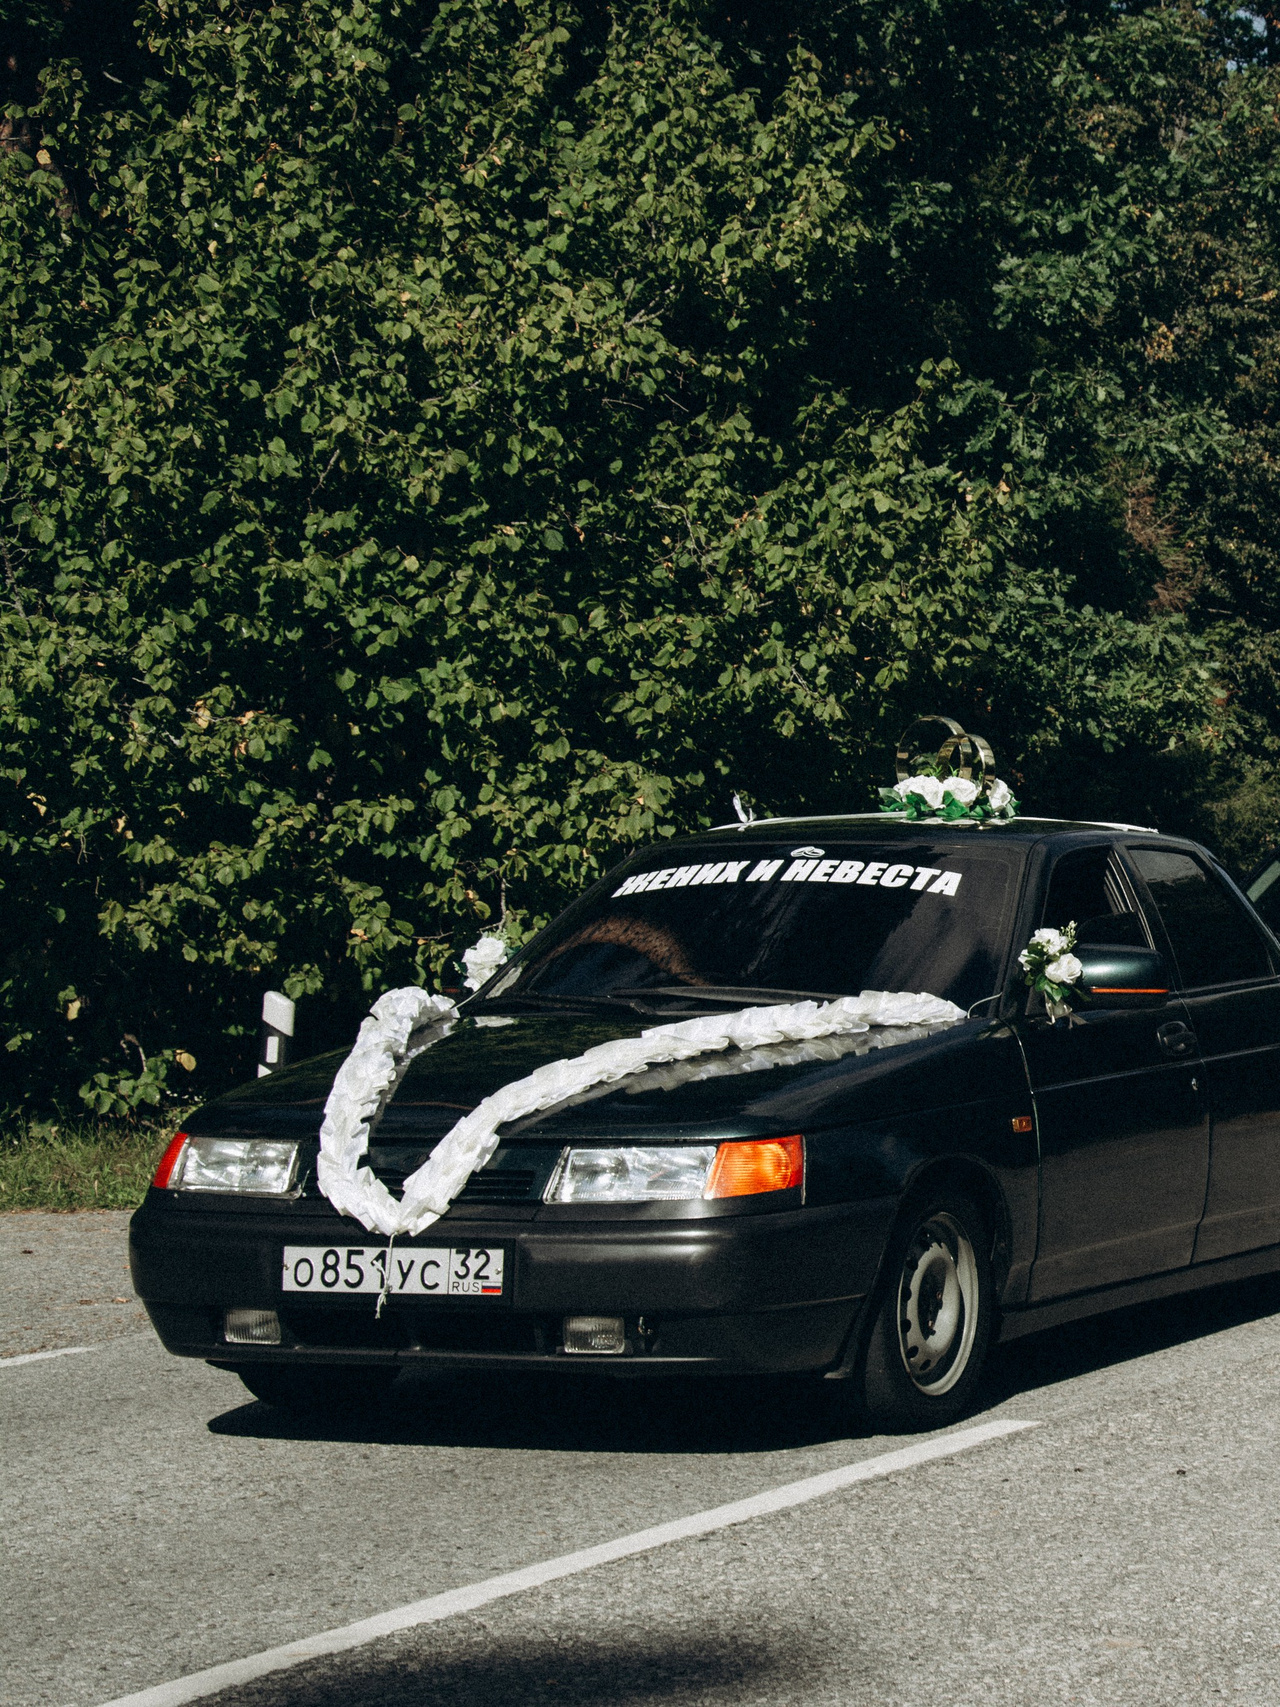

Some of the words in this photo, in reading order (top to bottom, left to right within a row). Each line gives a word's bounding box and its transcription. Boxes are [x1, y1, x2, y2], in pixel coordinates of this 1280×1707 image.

[611, 860, 751, 899] ЖЕНИХ
[745, 859, 785, 883] И
[780, 859, 963, 897] НЕВЕСТА
[454, 1248, 491, 1281] 32
[451, 1281, 480, 1293] RUS
